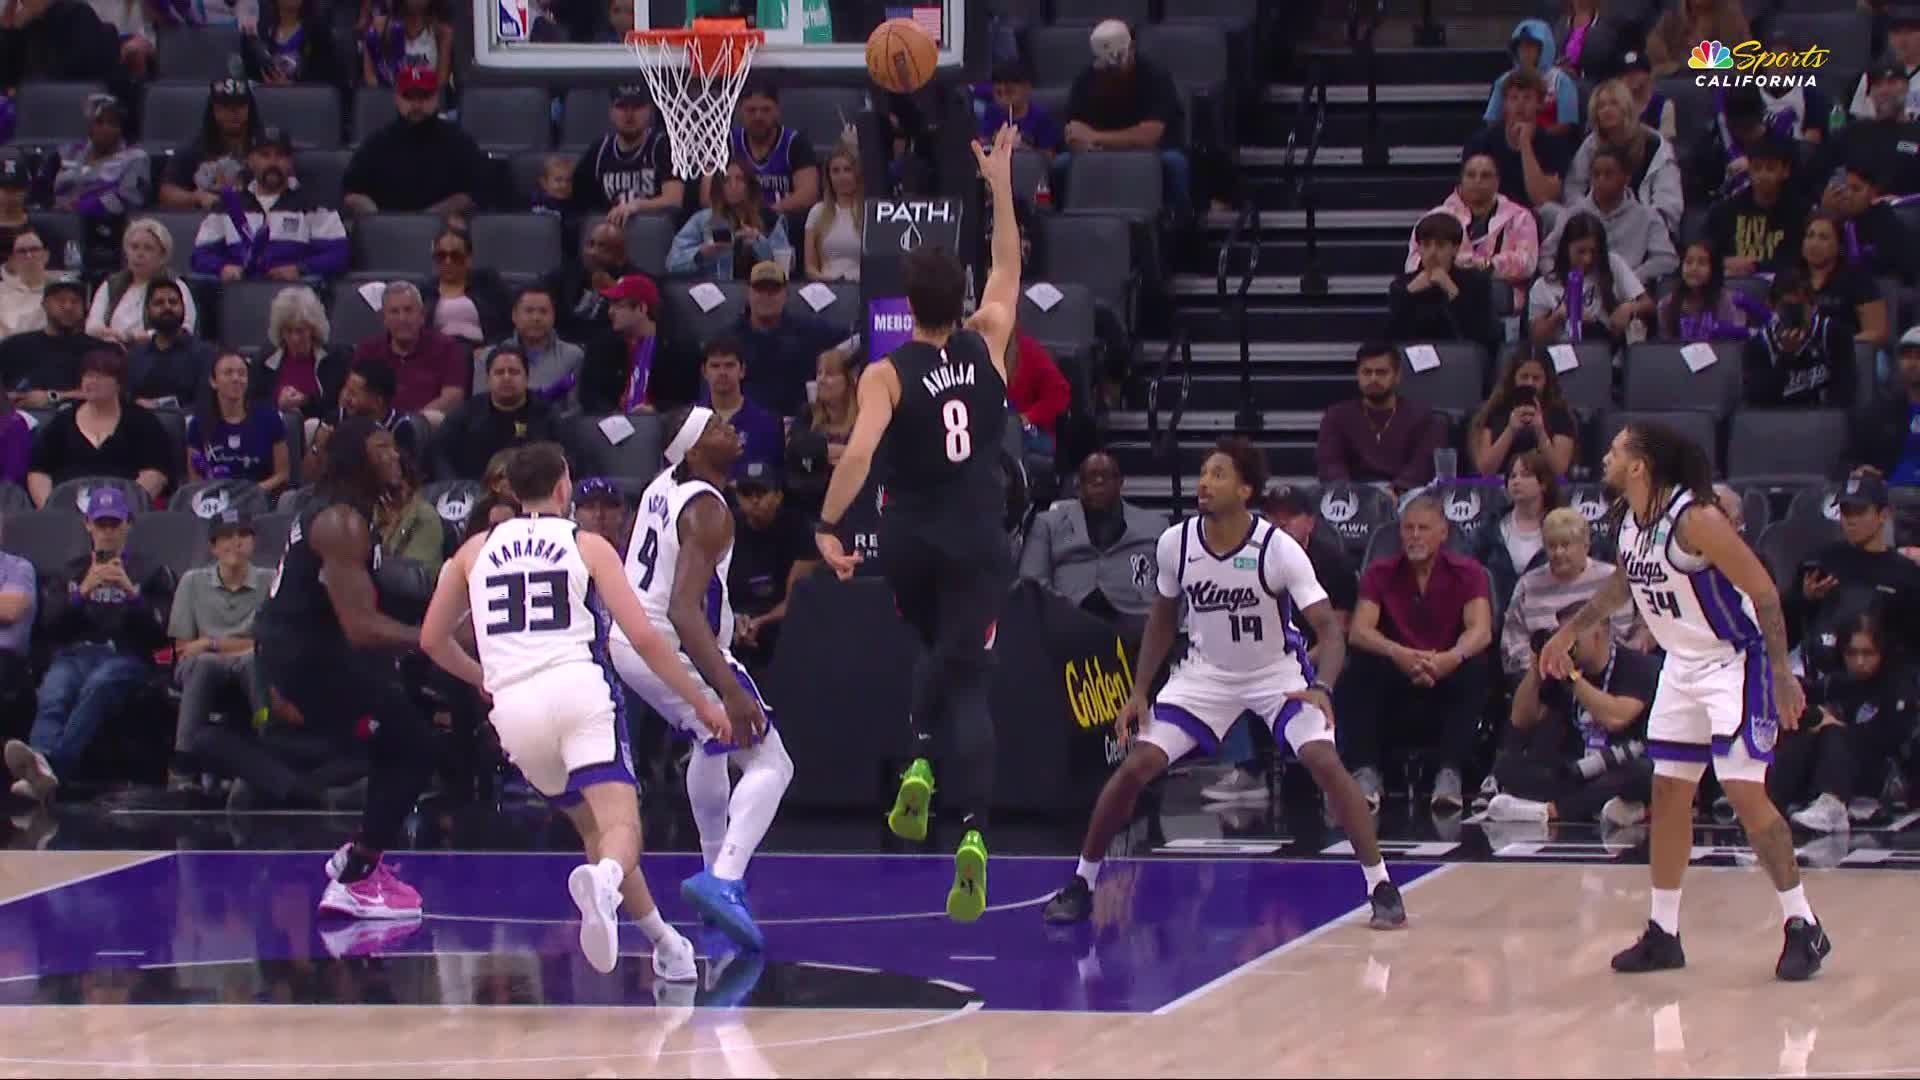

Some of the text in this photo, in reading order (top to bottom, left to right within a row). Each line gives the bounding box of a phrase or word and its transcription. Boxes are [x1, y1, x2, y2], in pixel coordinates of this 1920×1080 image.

[922, 362, 976, 398] AVDIJA
[942, 399, 971, 462] 8
[488, 538, 567, 568] KARABAN
[486, 570, 571, 635] 33
[1186, 580, 1259, 612] Kings
[1642, 588, 1682, 619] 34
[1228, 614, 1263, 642] 19
[1065, 655, 1130, 729] Golden
